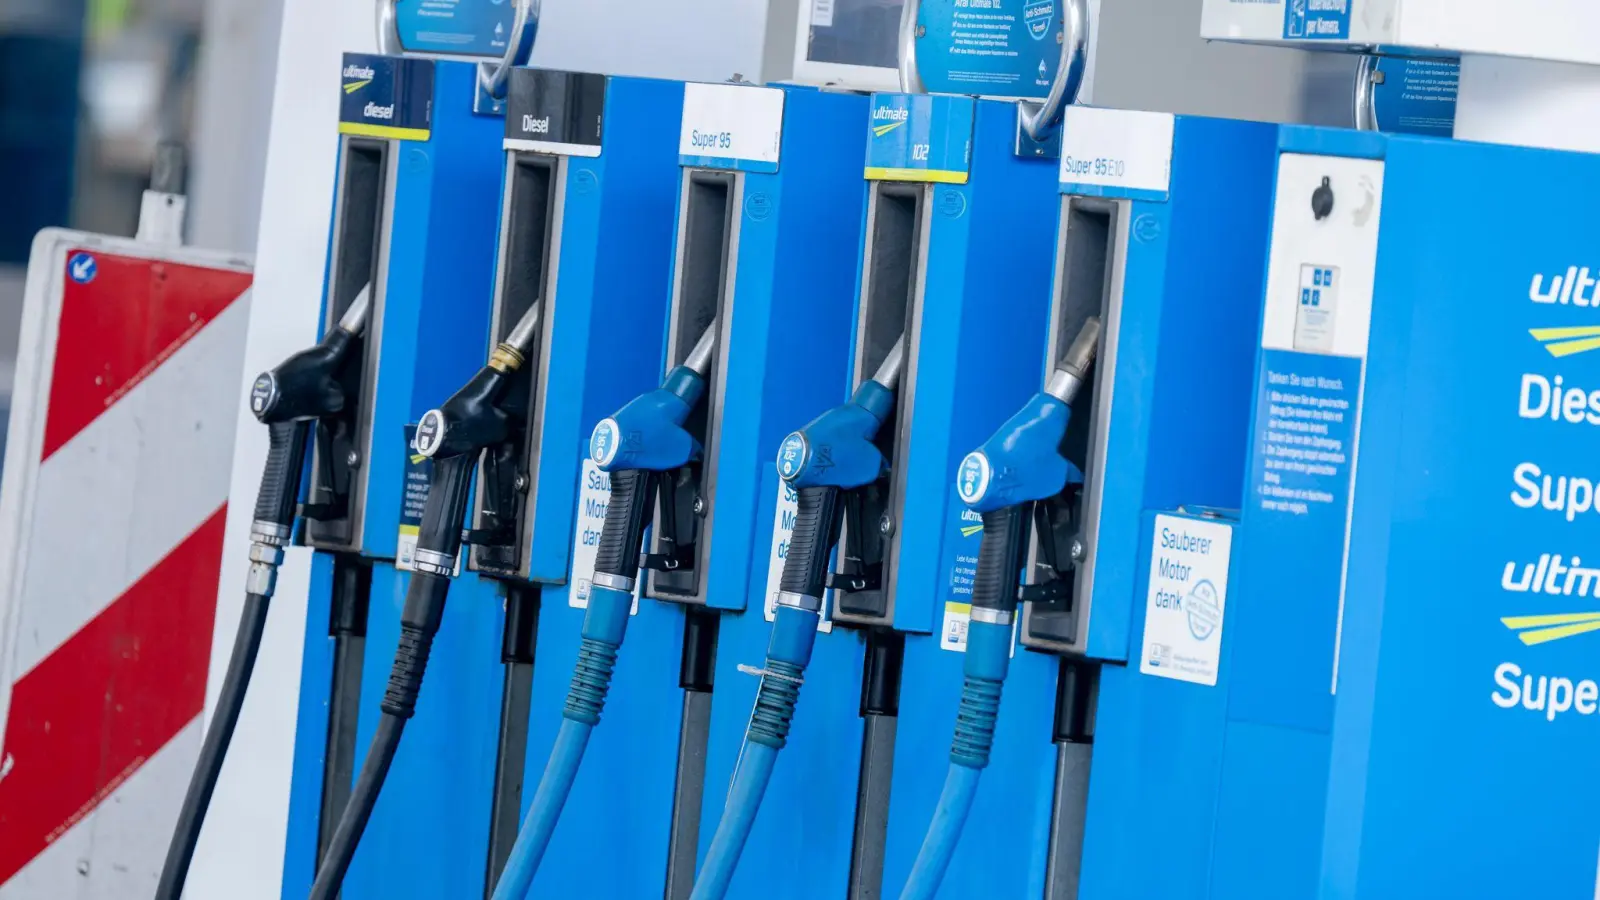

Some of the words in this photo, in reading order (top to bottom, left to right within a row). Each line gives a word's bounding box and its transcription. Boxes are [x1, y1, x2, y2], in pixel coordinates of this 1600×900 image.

[1306, 20, 1317, 37] per
[343, 64, 375, 80] ultimate
[364, 101, 394, 119] diesel
[873, 106, 909, 120] ultimate
[522, 114, 549, 134] Diesel
[691, 129, 718, 151] Super
[719, 131, 731, 148] 95
[912, 144, 930, 161] 102
[1065, 155, 1092, 177] Super
[1161, 527, 1212, 555] Sauberer
[1158, 556, 1192, 581] Motor
[1155, 588, 1183, 611] dank
[1491, 662, 1600, 722] Supe
